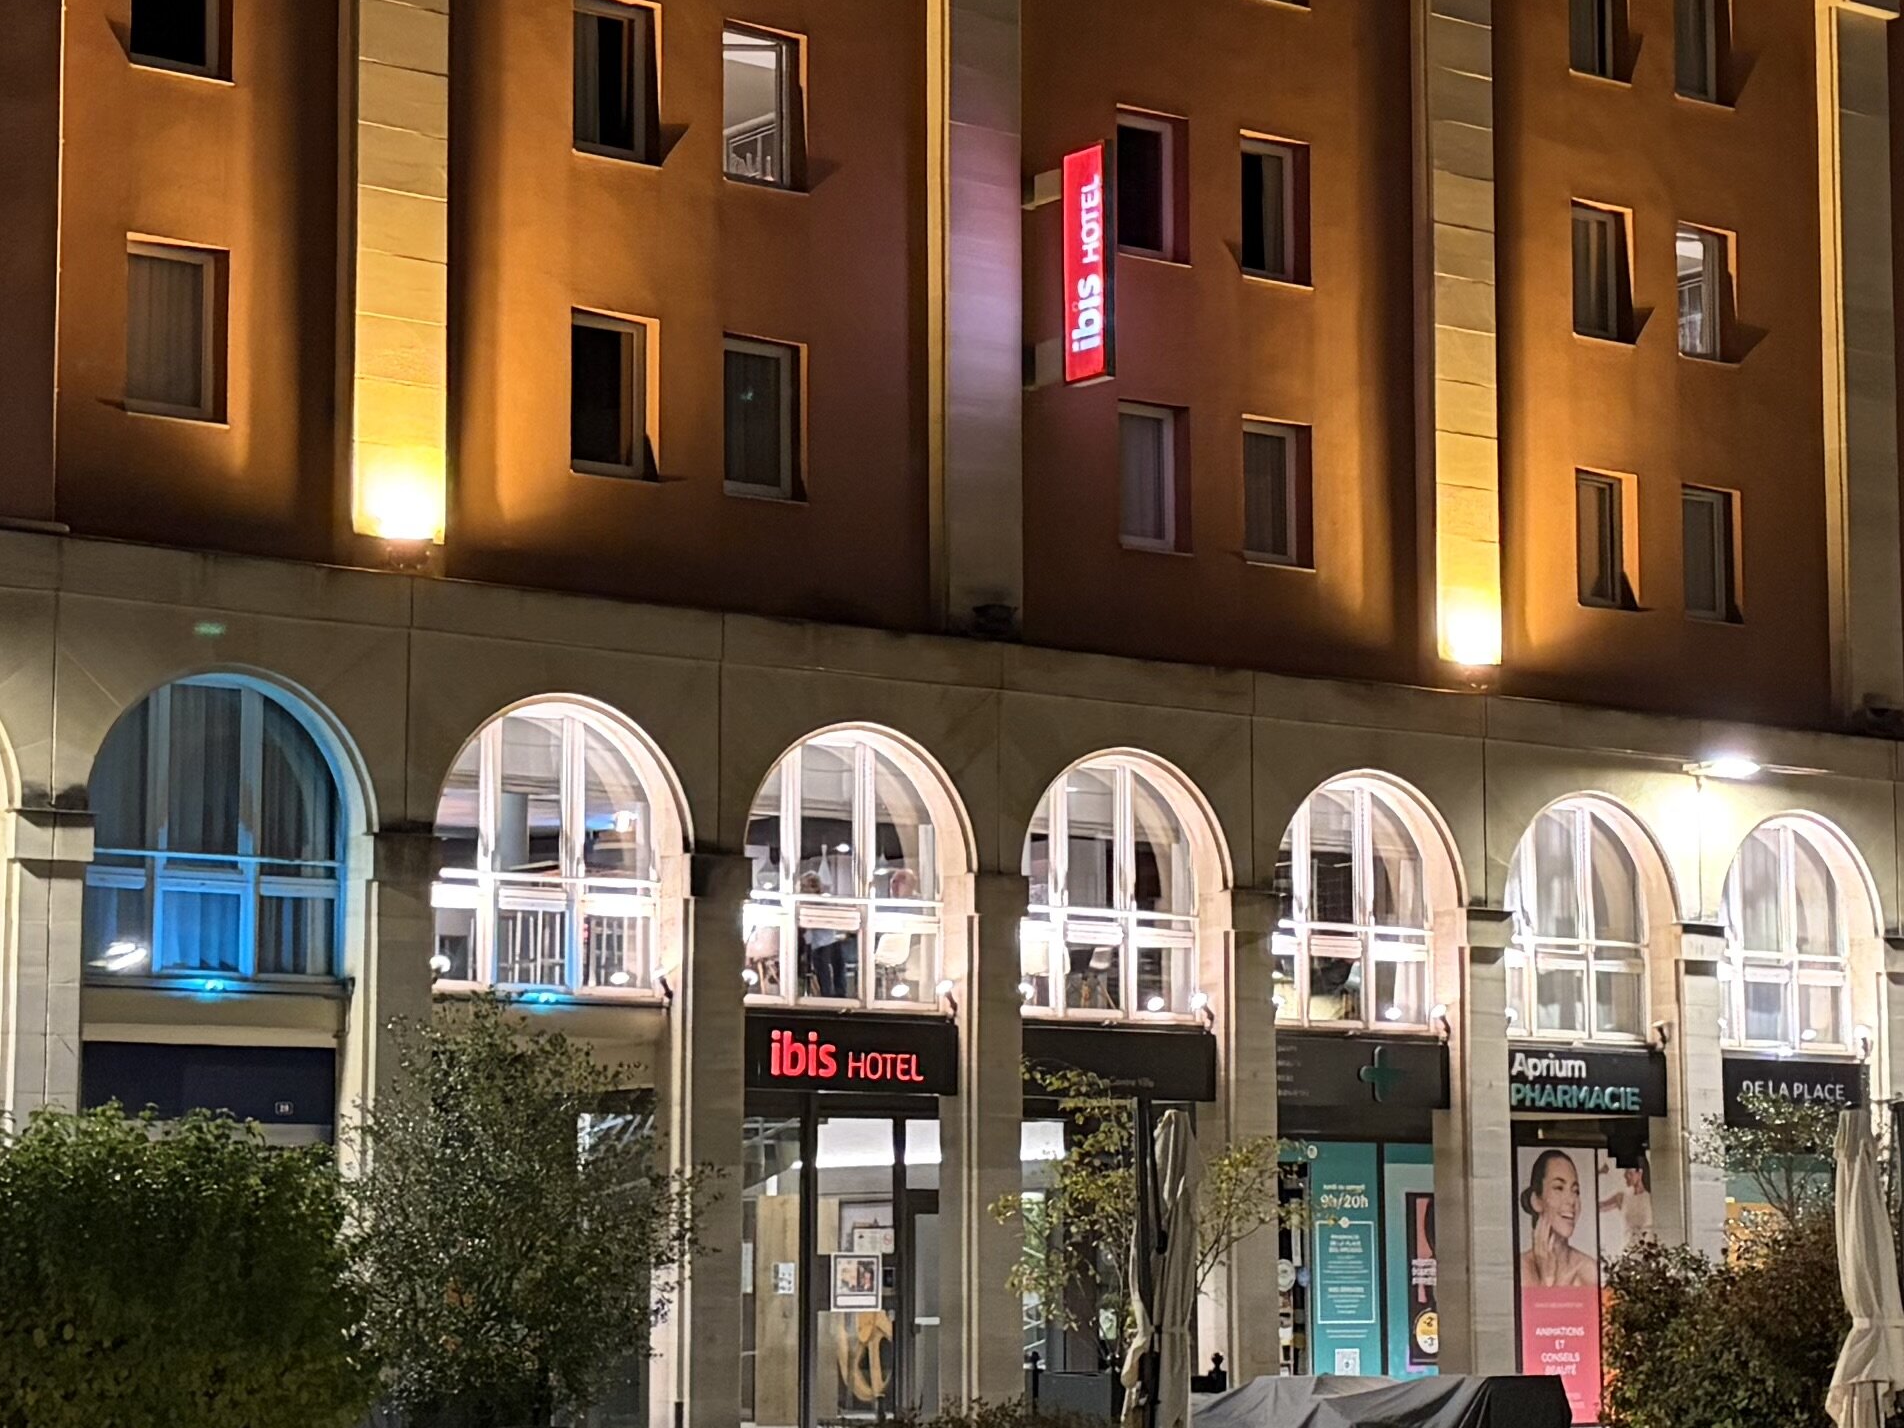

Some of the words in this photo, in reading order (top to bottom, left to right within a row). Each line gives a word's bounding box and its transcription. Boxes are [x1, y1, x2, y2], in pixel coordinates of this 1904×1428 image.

[1080, 173, 1103, 264] HOTEL
[1072, 273, 1103, 352] ibis
[771, 1030, 837, 1077] ibis
[848, 1051, 924, 1081] HOTEL
[1511, 1052, 1587, 1081] Aprium
[1510, 1083, 1642, 1111] PHARMACIE
[1742, 1080, 1764, 1096] DE
[1768, 1079, 1790, 1099] LA
[1793, 1082, 1845, 1100] PLACE
[1320, 1193, 1368, 1210] 9h/20h
[1541, 1352, 1580, 1362] CONSEILS
